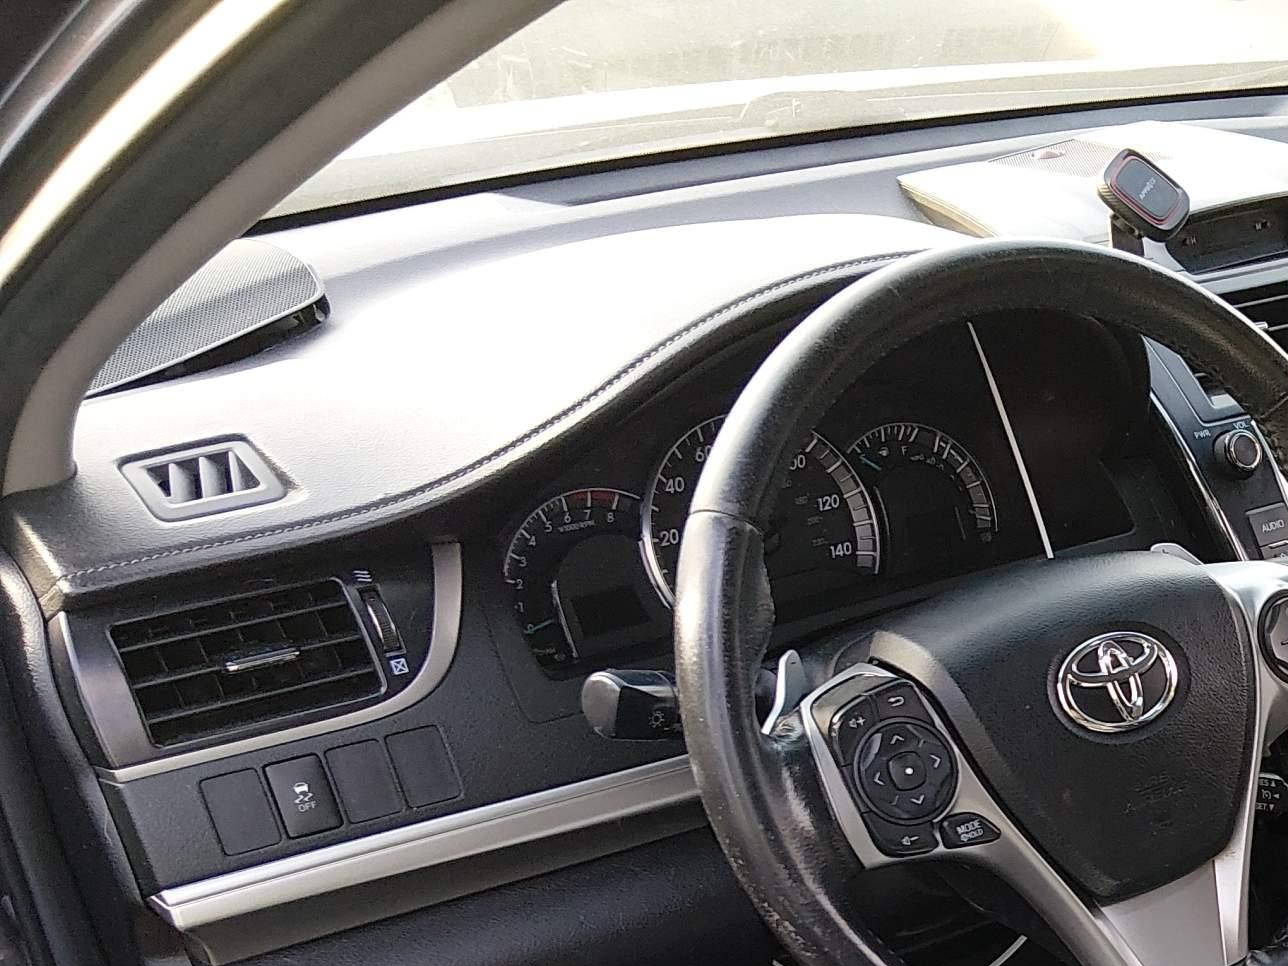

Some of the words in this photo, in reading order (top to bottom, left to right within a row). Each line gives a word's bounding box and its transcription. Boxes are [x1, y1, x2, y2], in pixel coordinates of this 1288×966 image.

[1233, 421, 1249, 429] VOL
[1194, 429, 1211, 439] PWR
[665, 477, 685, 494] 40
[816, 494, 840, 512] 120
[564, 511, 571, 523] 6
[583, 509, 591, 521] 7
[607, 512, 615, 522] 8
[544, 521, 553, 533] 5
[1262, 519, 1284, 533] AUDIO
[528, 535, 537, 546] 4
[660, 529, 679, 546] 20
[829, 542, 852, 559] 140
[520, 556, 528, 567] 3
[515, 578, 524, 590] 2
[298, 800, 317, 812] OFF
[956, 819, 981, 834] MODE
